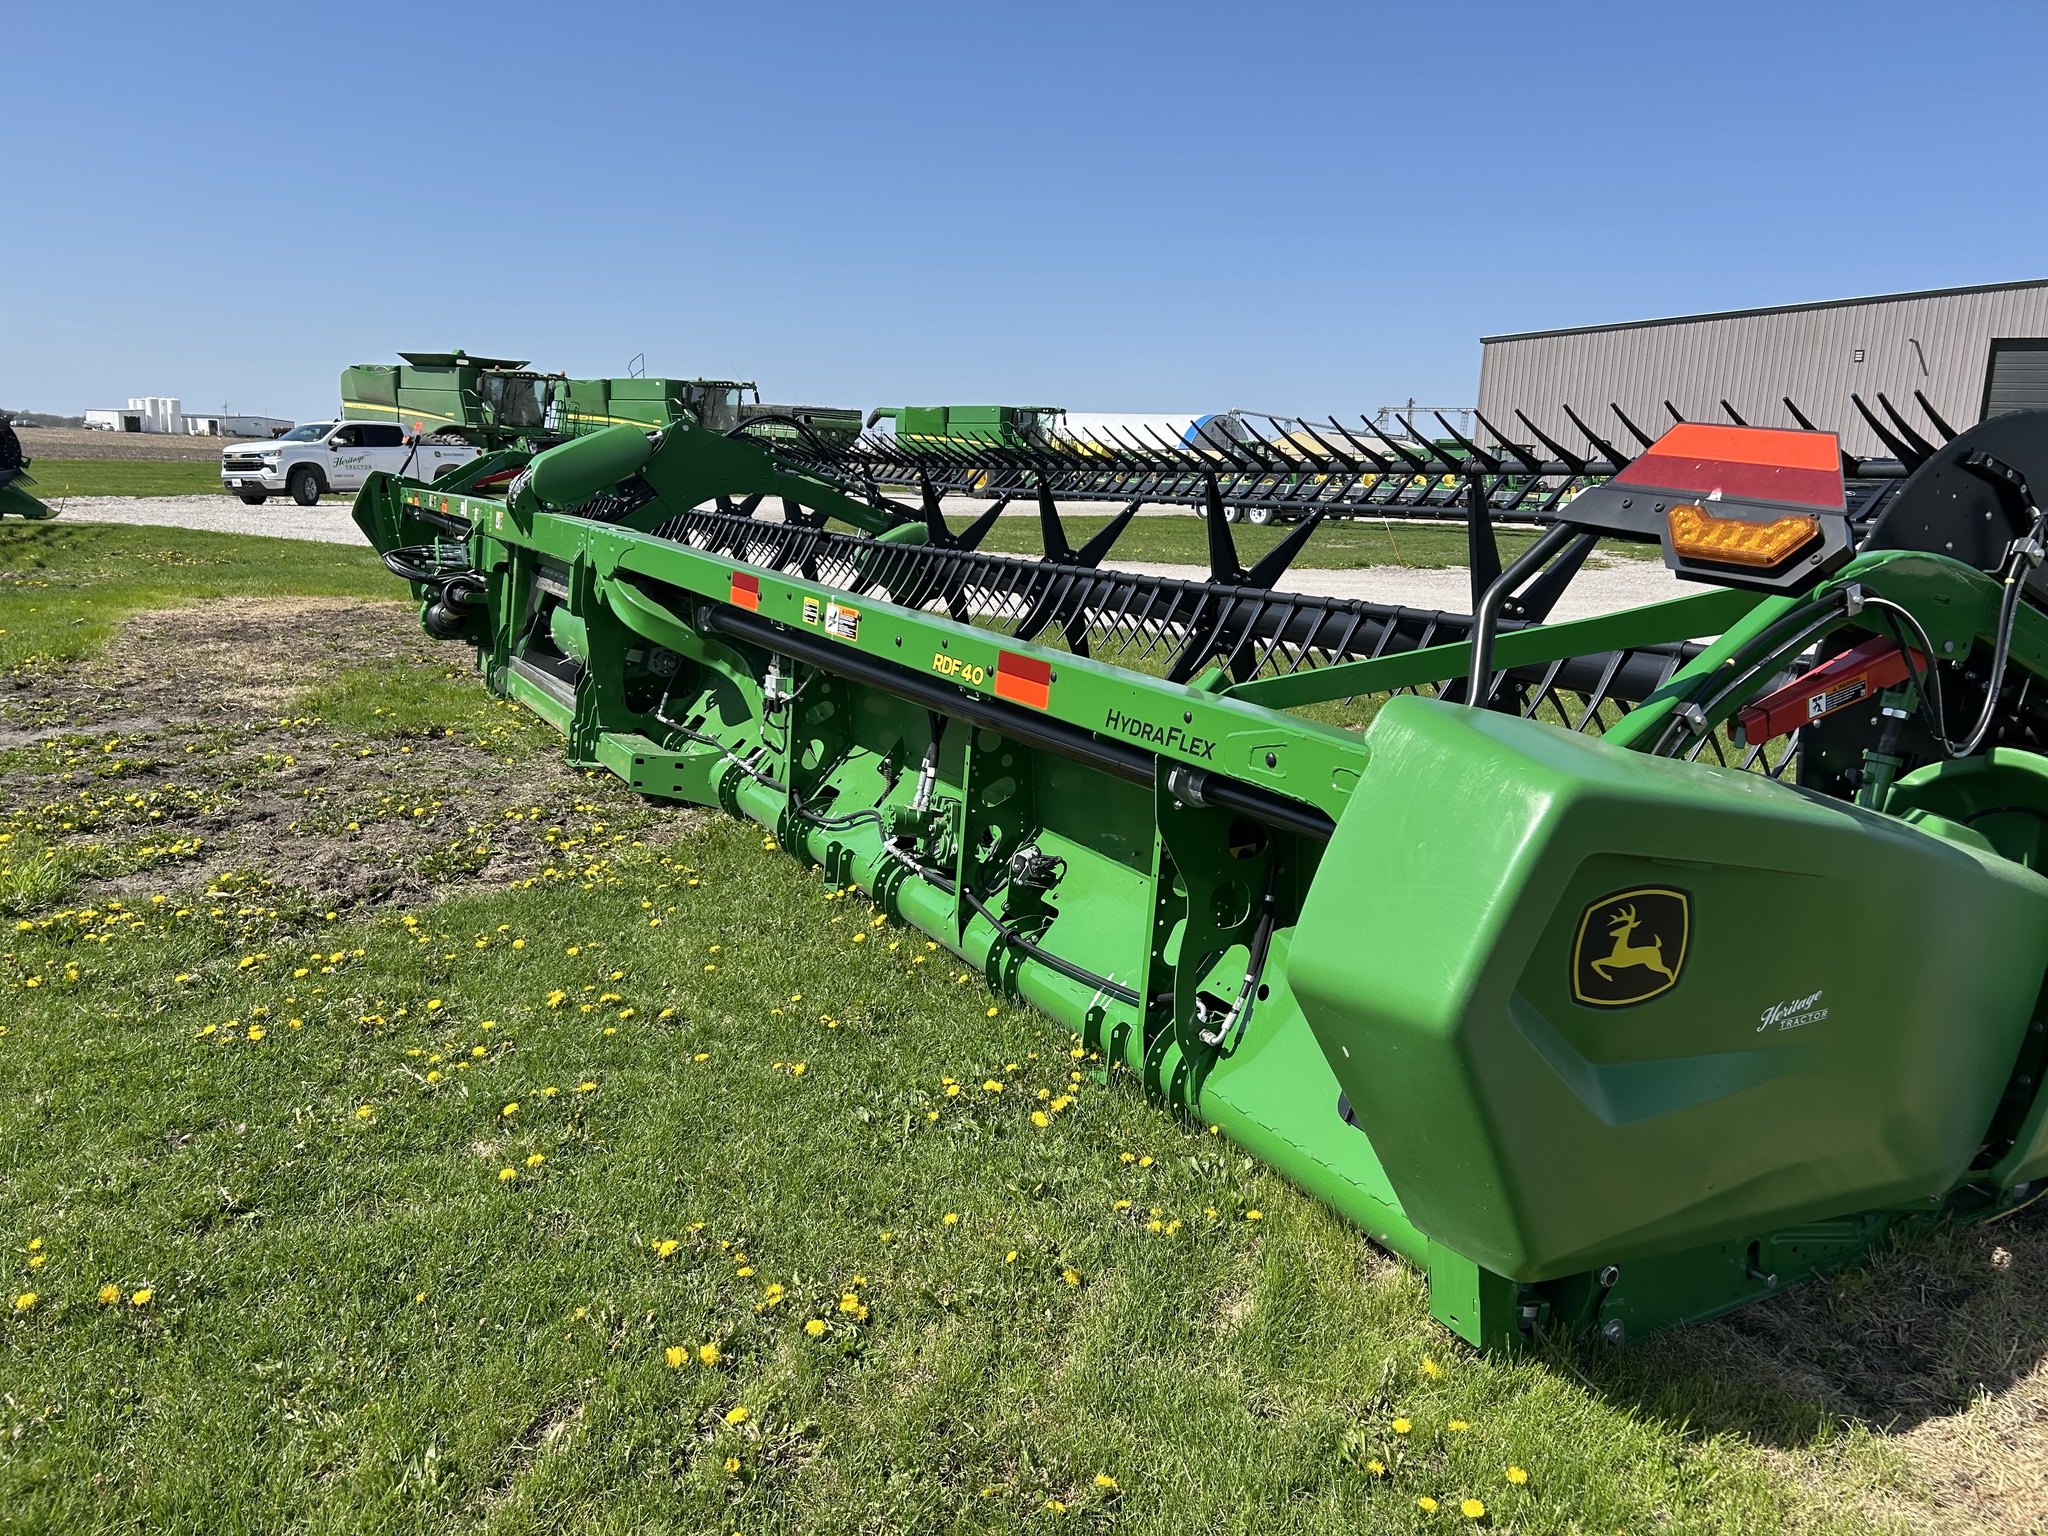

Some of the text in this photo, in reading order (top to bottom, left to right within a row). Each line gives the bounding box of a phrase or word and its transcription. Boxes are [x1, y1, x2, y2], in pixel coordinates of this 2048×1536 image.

[333, 455, 366, 468] Heritage
[932, 652, 984, 686] RDF 40
[1756, 990, 1823, 1033] Heritage
[1780, 1010, 1828, 1029] TRACTOR
